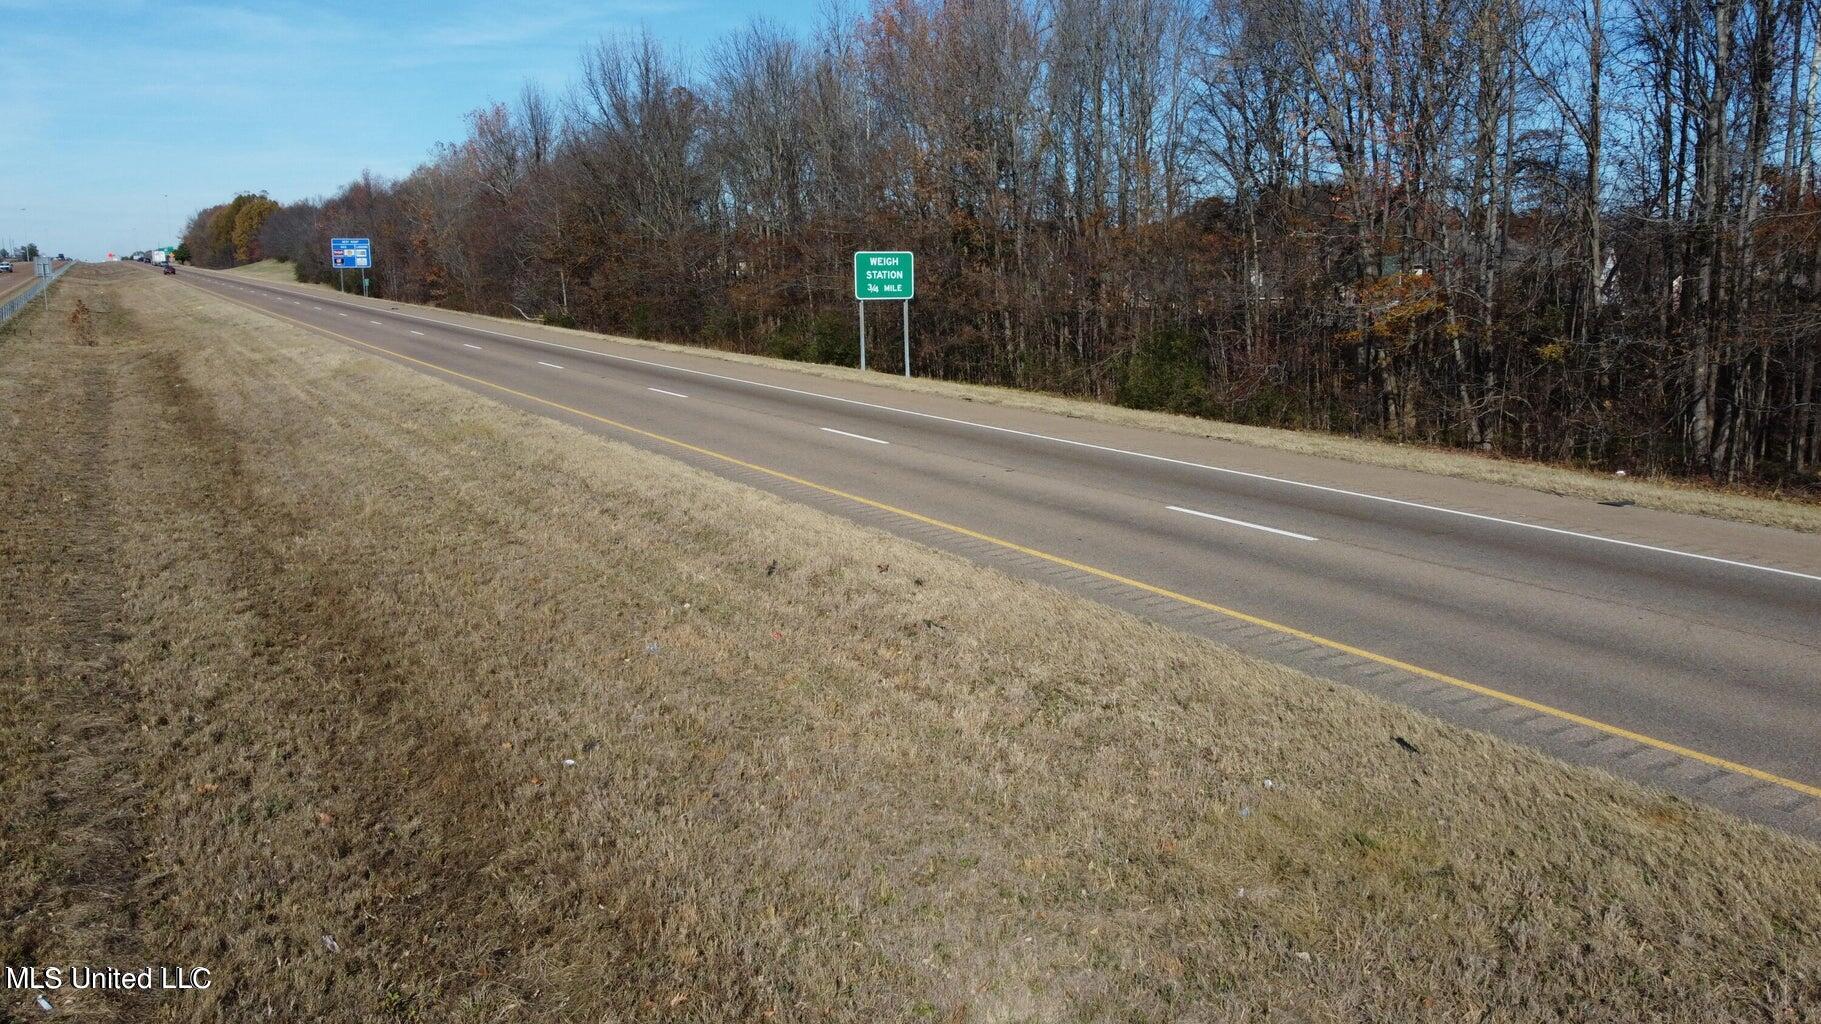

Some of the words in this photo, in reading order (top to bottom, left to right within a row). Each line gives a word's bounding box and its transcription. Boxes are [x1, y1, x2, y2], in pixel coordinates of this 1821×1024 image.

[870, 257, 899, 266] WEIGH
[866, 270, 903, 279] STATION
[884, 284, 903, 292] MILE
